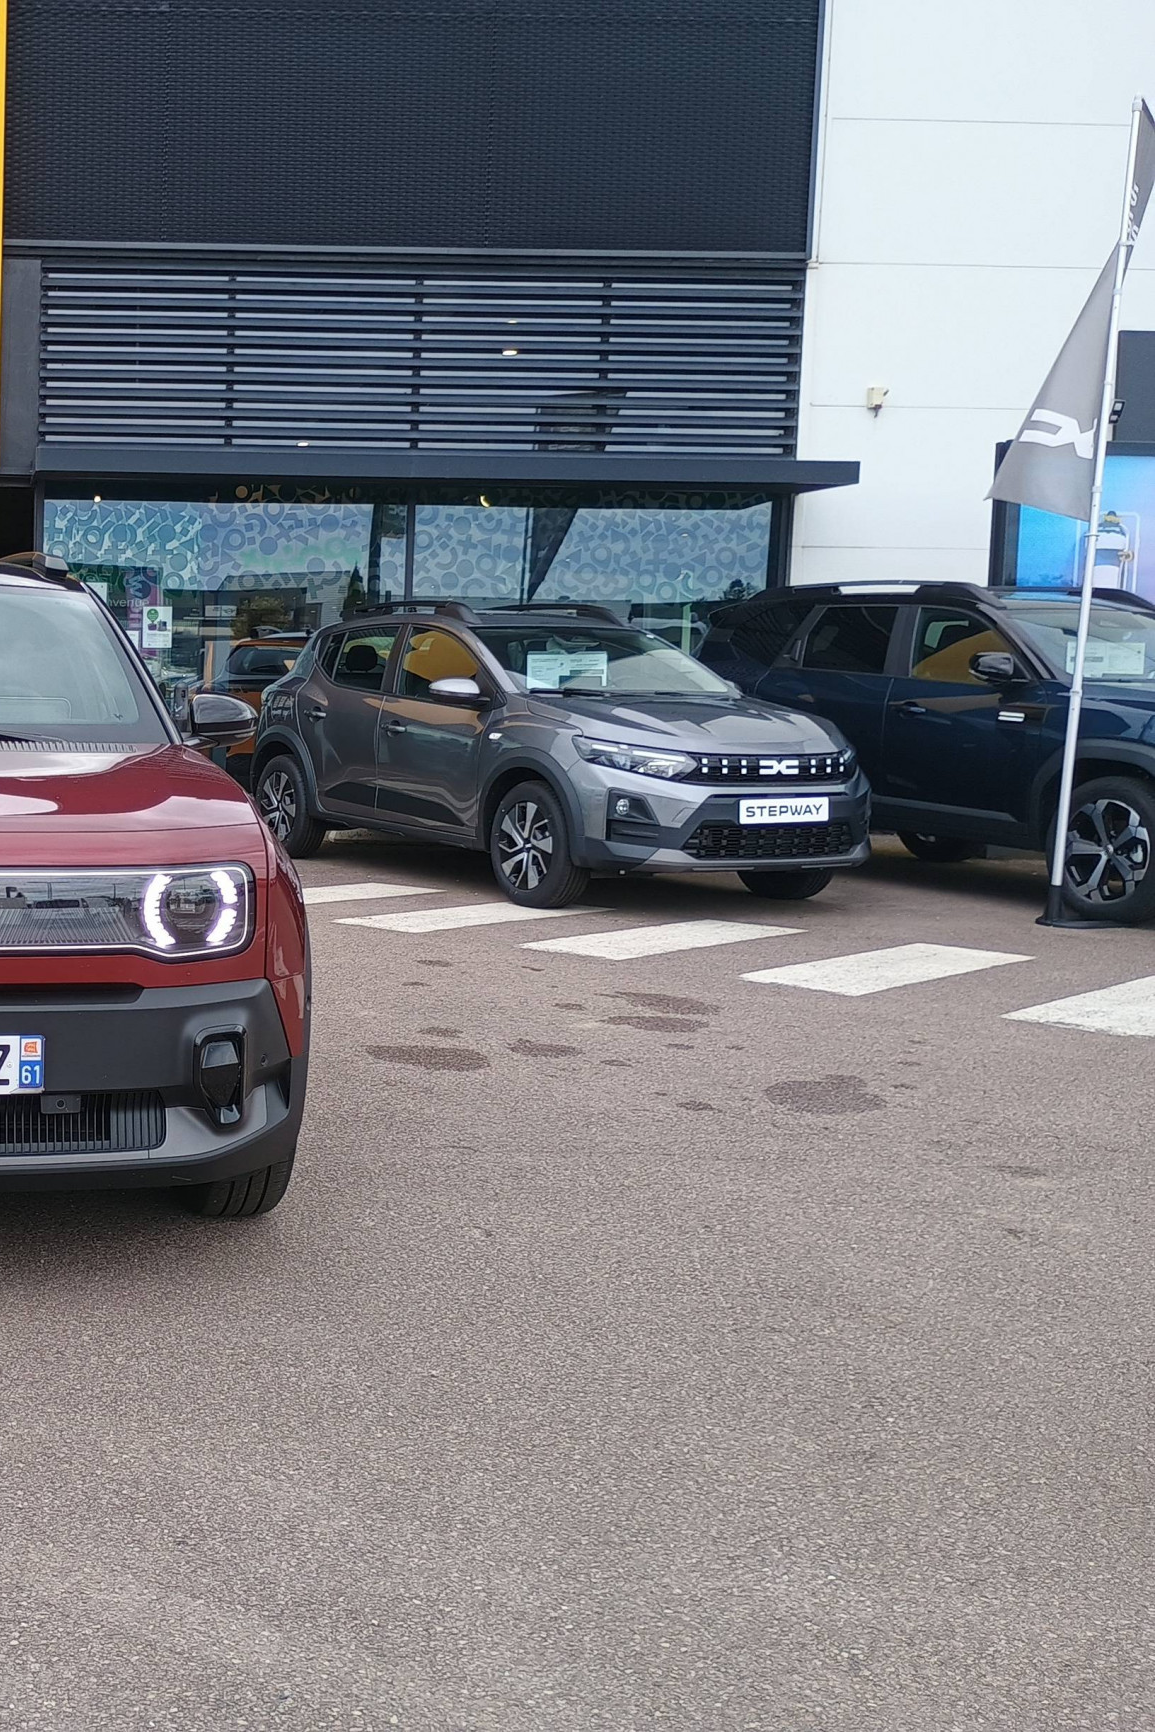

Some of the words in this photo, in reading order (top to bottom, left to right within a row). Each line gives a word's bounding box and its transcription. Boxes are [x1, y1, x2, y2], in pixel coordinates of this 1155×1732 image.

[107, 597, 149, 608] nvenue
[746, 804, 822, 817] STEPWAY
[21, 1064, 41, 1085] 61
